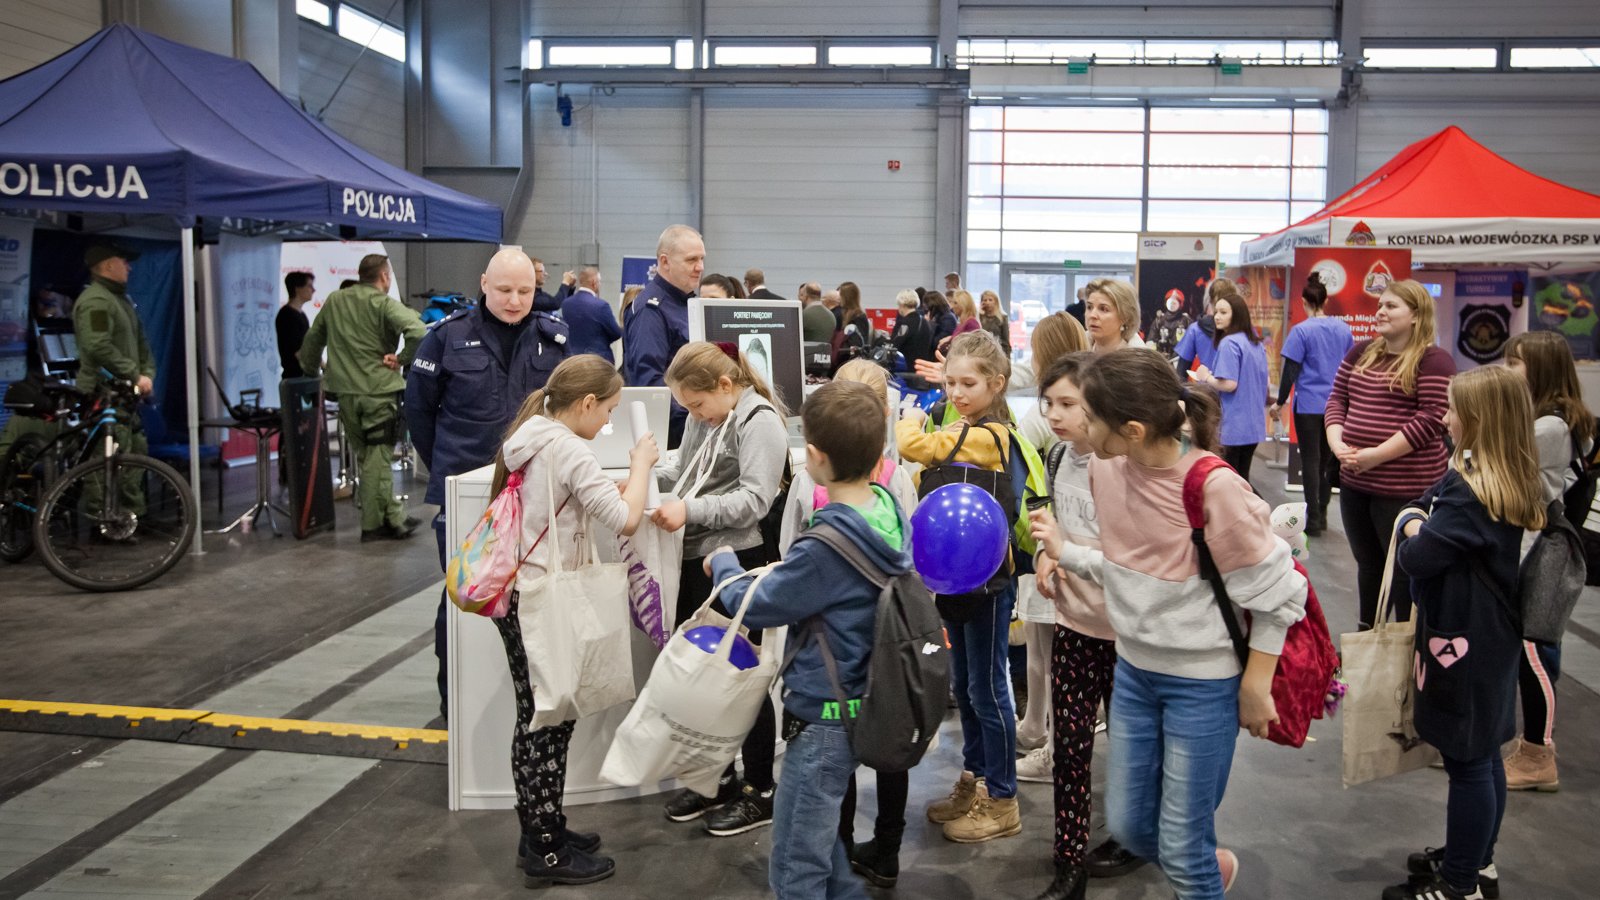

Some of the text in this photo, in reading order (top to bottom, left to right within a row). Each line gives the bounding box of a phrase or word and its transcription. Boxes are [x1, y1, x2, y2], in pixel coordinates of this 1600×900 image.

[343, 187, 416, 223] POLICJA
[1387, 234, 1454, 245] KOMENDA
[1459, 231, 1558, 244] WOJEWÓDZKA
[1563, 234, 1589, 244] PSP
[1355, 314, 1377, 323] Miejs
[413, 358, 436, 372] POLICJA
